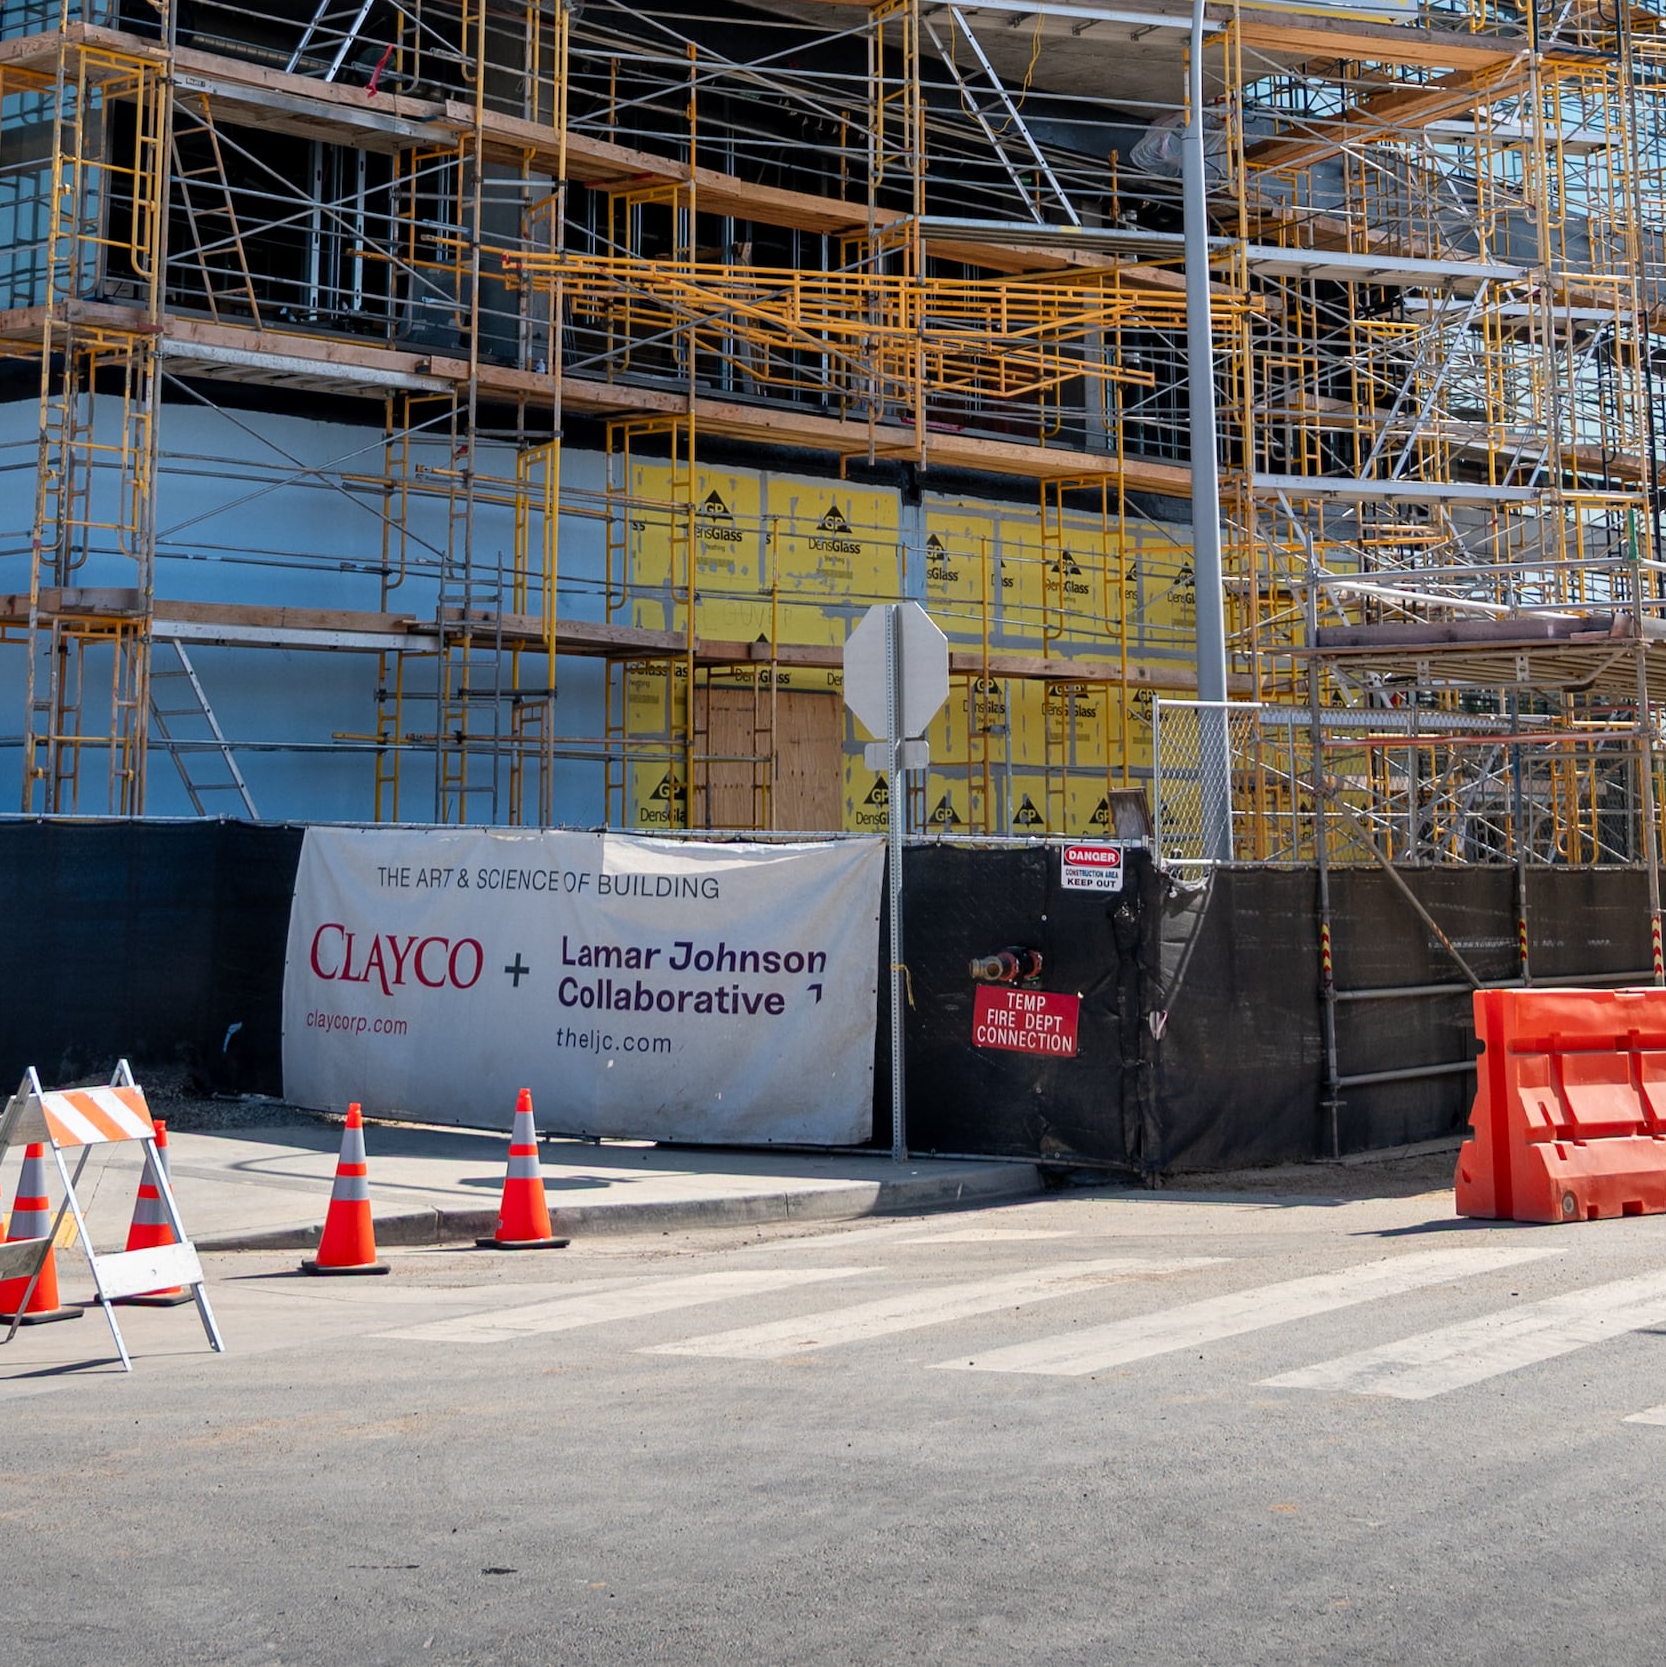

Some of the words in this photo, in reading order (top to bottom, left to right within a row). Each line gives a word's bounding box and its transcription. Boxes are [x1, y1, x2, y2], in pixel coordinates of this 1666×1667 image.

[706, 501, 724, 515] GP
[824, 516, 842, 530] GP
[695, 526, 743, 543] ensGlass
[808, 536, 861, 555] DensGlass
[871, 787, 889, 802] GP
[935, 807, 953, 821] GP
[1068, 849, 1116, 863] DANGER
[377, 866, 411, 888] THE
[415, 867, 454, 888] ART
[457, 869, 471, 889] &
[476, 867, 559, 892] SCIENCE
[564, 871, 592, 893] OF
[597, 873, 720, 900] BUILDING
[1065, 868, 1104, 878] CONSTRUCTION
[1105, 869, 1119, 879] AREA
[1067, 877, 1094, 887] KEEP
[1096, 879, 1117, 889] OUT
[309, 922, 484, 997] CLAYCO
[561, 935, 661, 971] Lamar
[668, 941, 826, 975] Johnson
[558, 976, 786, 1016] Collaborative
[1007, 992, 1046, 1012] TEMP
[306, 1009, 408, 1036] claycorp.com
[987, 1008, 1016, 1029] FIRE
[1024, 1012, 1063, 1033] DEPT
[556, 1026, 673, 1055] theljc.com
[976, 1025, 1073, 1053] CONNECTION
